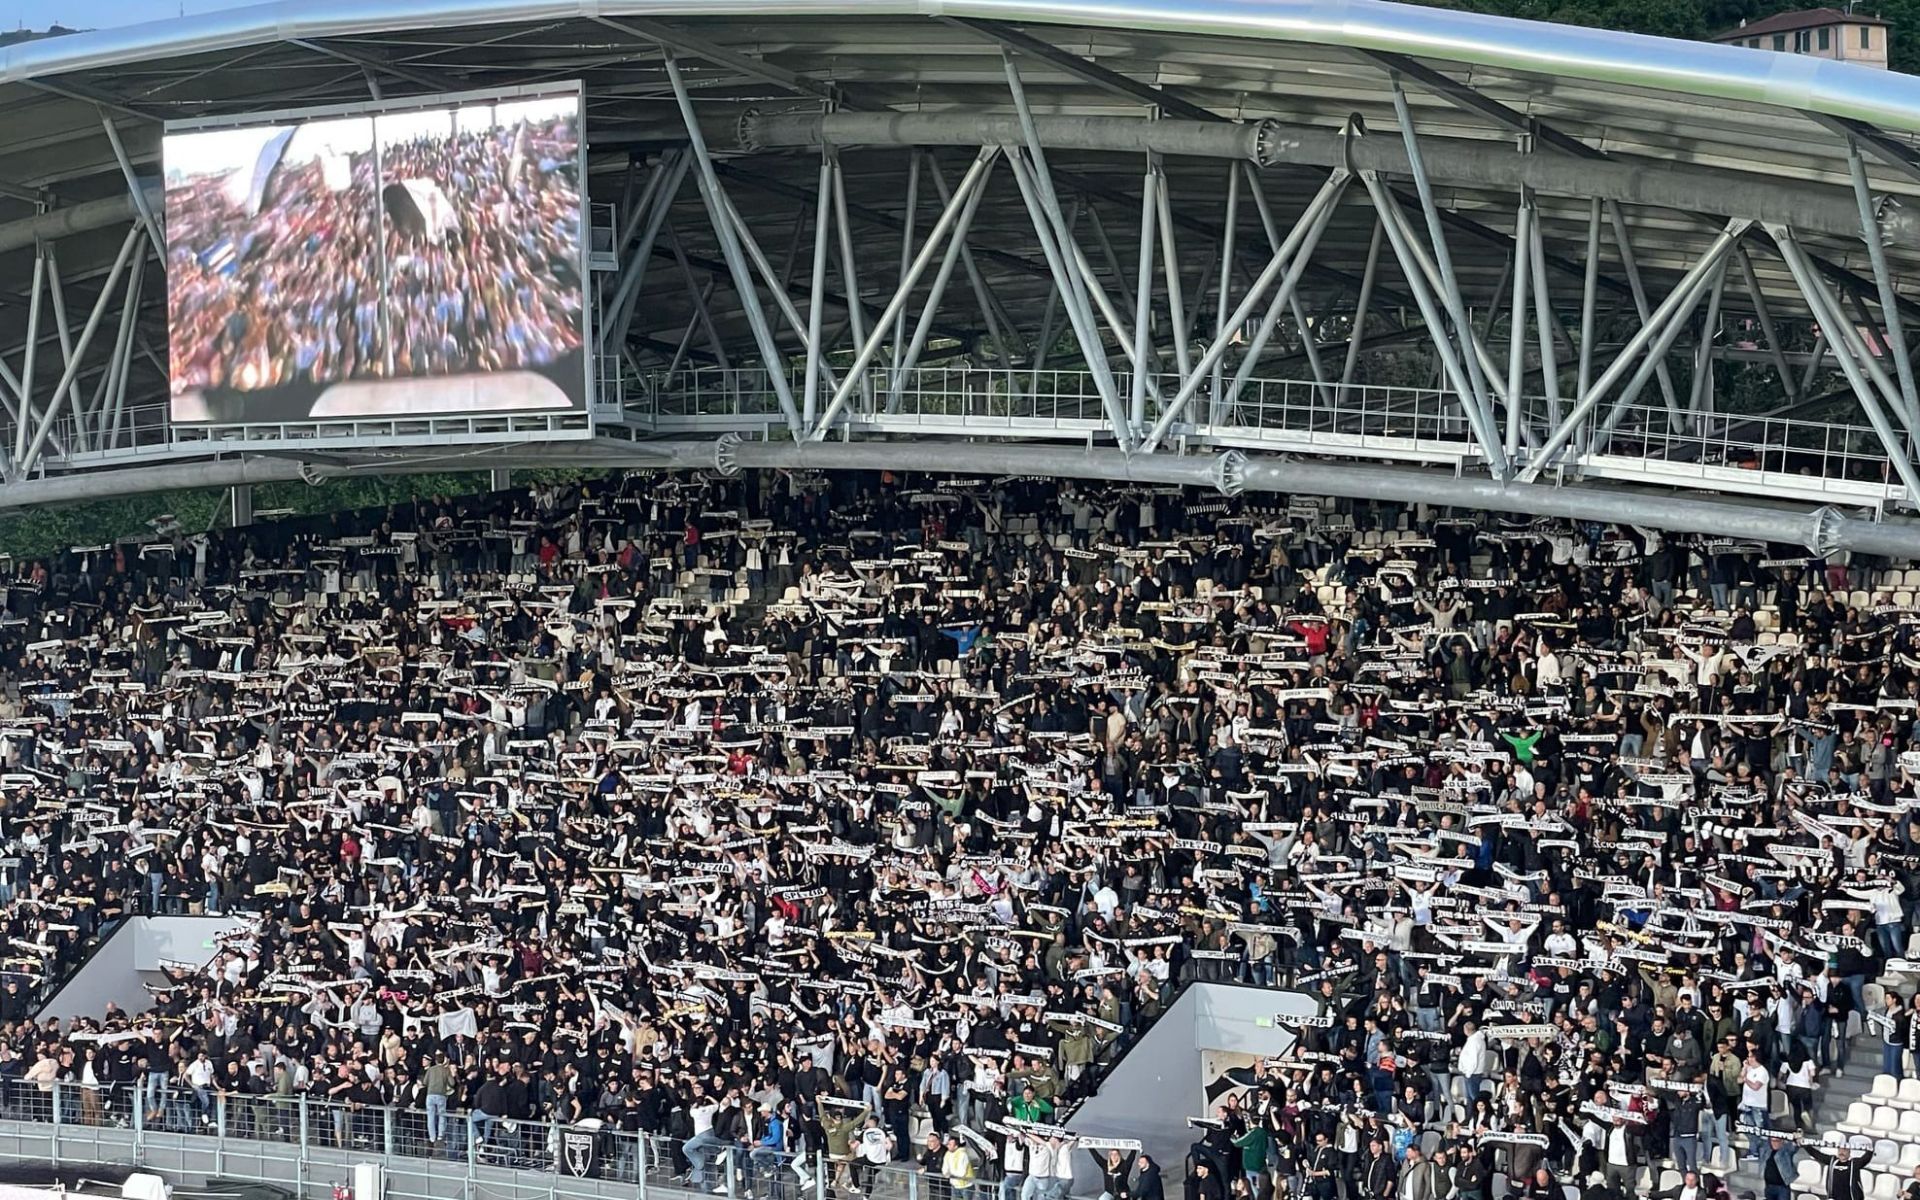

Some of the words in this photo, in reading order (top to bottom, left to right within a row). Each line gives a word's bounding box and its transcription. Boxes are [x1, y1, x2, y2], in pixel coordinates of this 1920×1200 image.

[1175, 840, 1219, 851] SPEZIA
[785, 889, 823, 899] SPEZIA
[1276, 1014, 1328, 1026] SPEZIA
